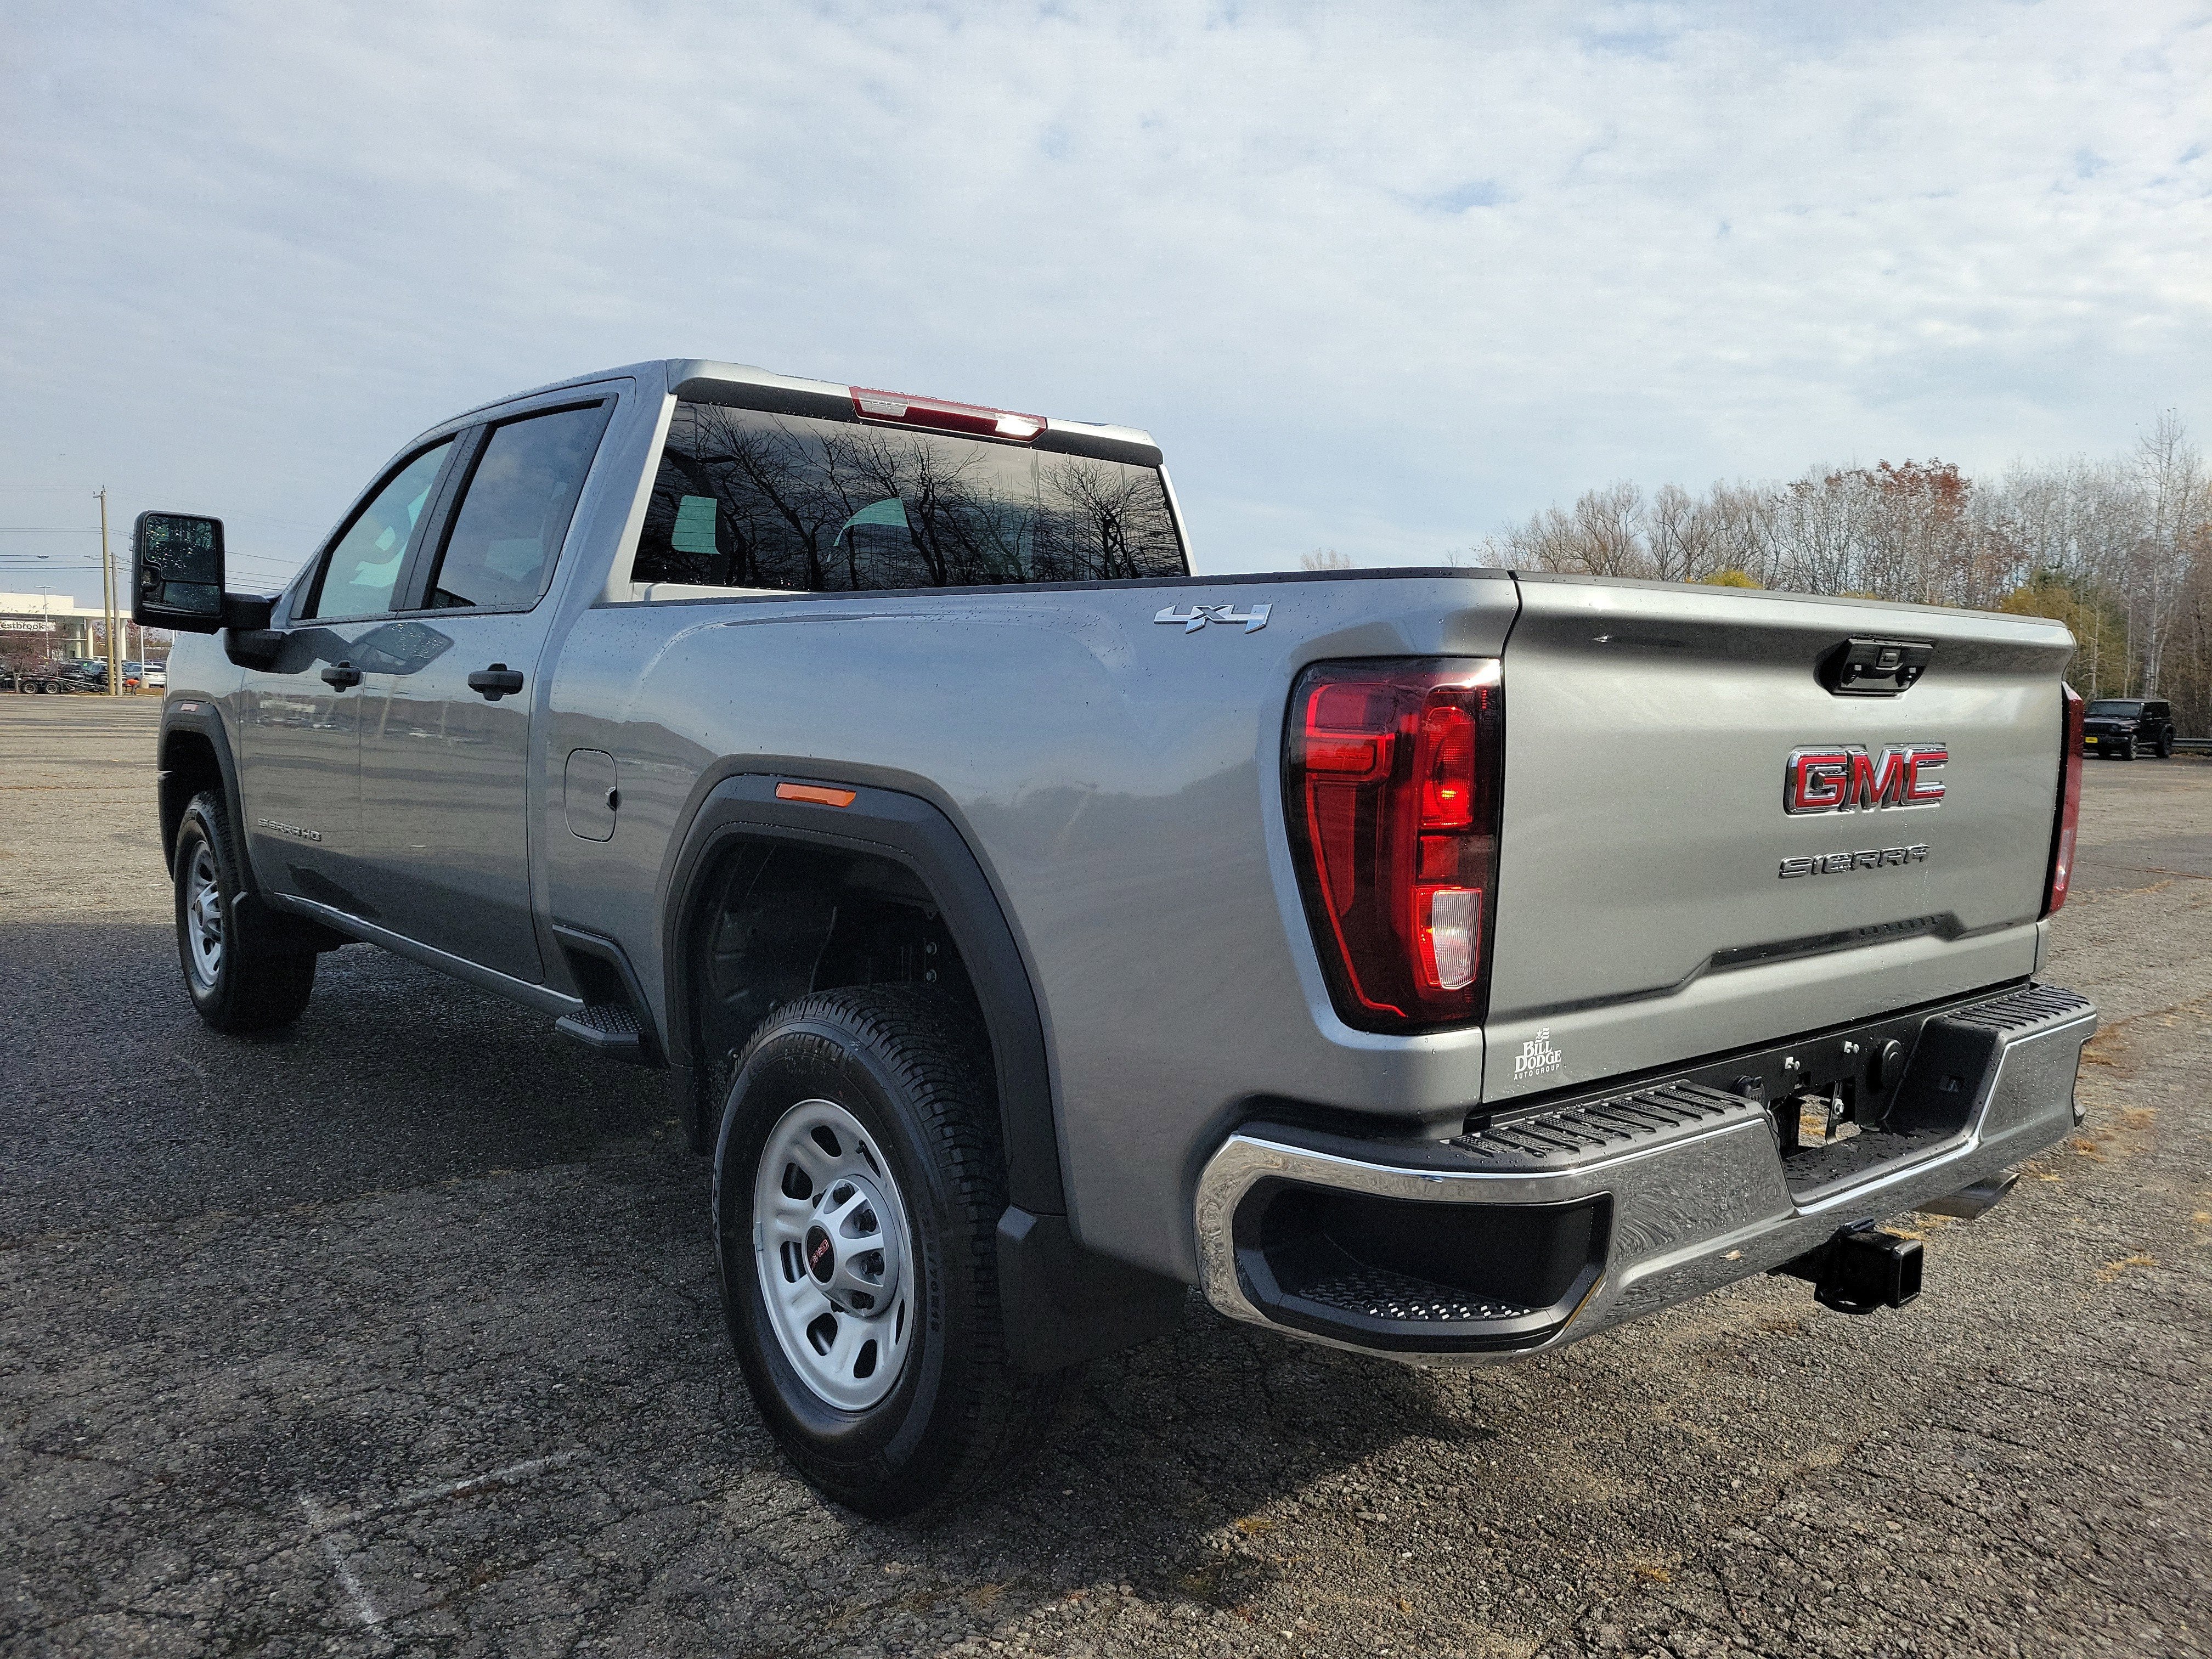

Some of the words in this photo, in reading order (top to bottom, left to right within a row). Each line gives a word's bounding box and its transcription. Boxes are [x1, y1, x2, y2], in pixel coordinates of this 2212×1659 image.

[1784, 743, 1948, 816] GMC
[1778, 844, 1929, 878] SIERRA
[1514, 1049, 1562, 1073] DODGE
[1522, 1041, 1553, 1057] BILL
[1514, 1070, 1533, 1081] AUTO
[1535, 1063, 1560, 1075] GROUP
[809, 1239, 830, 1270] GMC
